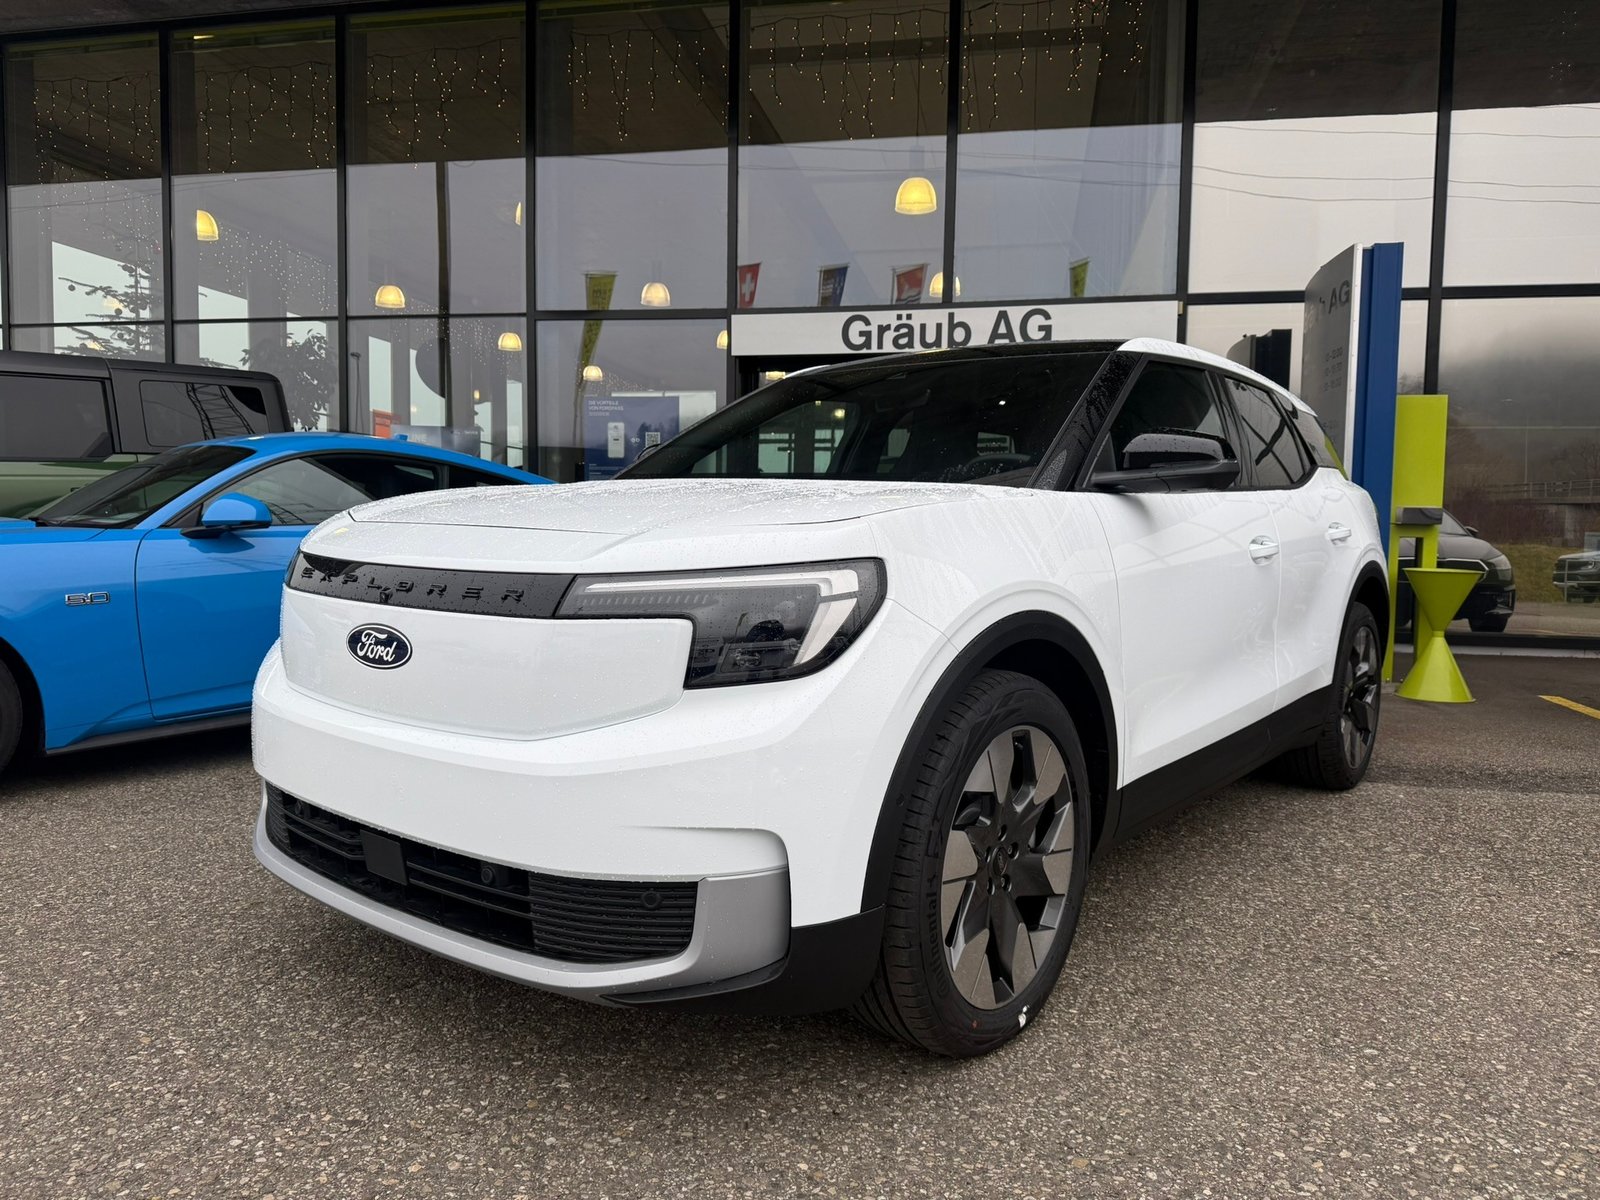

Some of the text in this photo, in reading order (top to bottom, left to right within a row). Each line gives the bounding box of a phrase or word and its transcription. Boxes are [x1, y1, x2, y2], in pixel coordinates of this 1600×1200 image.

[842, 308, 1053, 350] Gräub AG
[65, 592, 110, 605] 5.0
[301, 566, 524, 602] EXPLORER
[356, 629, 397, 662] Ford
